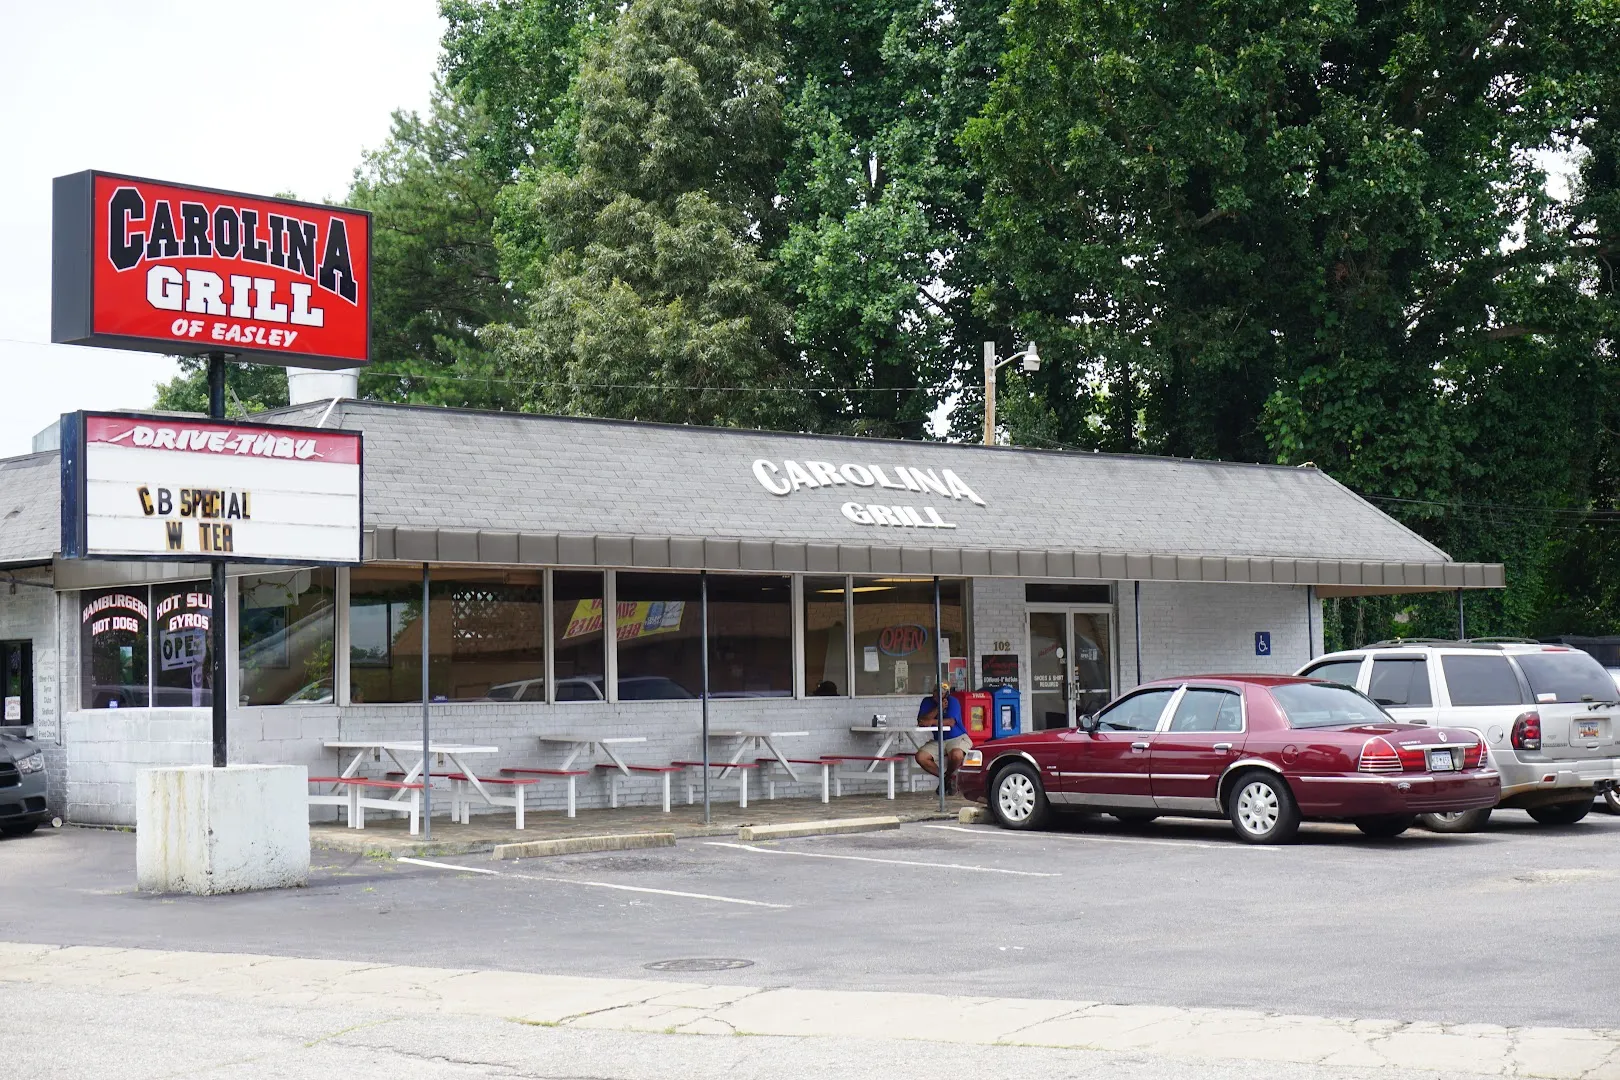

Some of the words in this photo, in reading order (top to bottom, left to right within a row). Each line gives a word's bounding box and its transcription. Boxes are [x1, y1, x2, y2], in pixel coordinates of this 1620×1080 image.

[108, 187, 358, 307] CAROLINA
[146, 264, 324, 328] GRILL
[171, 318, 205, 338] OF
[211, 322, 298, 348] EASLEY
[752, 458, 987, 508] CAROLINA
[180, 488, 251, 519] SPECIAL
[840, 501, 957, 529] GRILL
[199, 522, 234, 552] TEA
[82, 594, 148, 623] HAMBURGERS
[156, 594, 182, 621] HOT
[92, 617, 110, 636] HOT
[113, 616, 138, 633] DOGS
[169, 613, 209, 632] GYROS
[163, 634, 202, 660] OPE
[879, 626, 925, 651] OPEN
[993, 640, 1011, 652] 102
